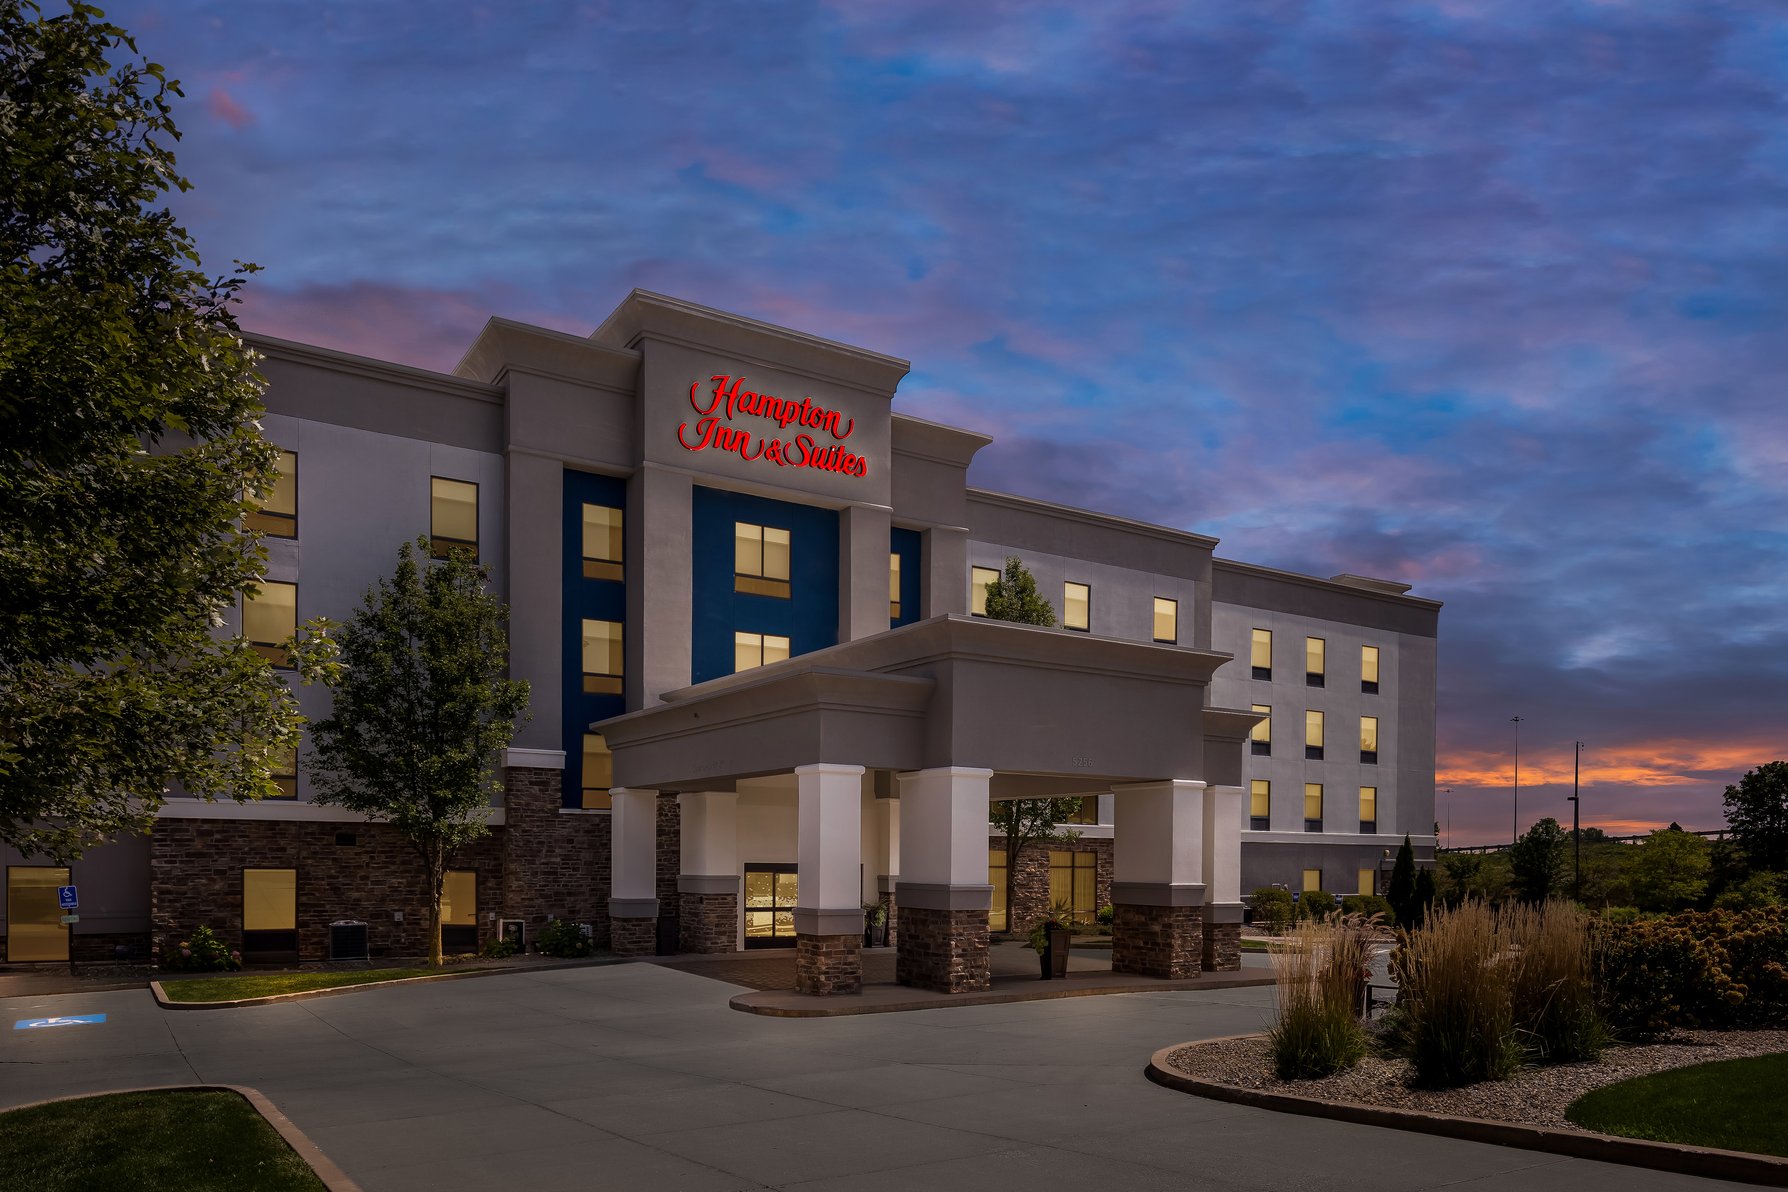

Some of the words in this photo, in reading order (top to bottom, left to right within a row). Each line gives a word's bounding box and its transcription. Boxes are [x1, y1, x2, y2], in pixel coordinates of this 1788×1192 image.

[690, 375, 854, 439] Hampton
[678, 417, 765, 461] Inn
[764, 439, 788, 466] &
[783, 433, 868, 477] Suites
[1072, 757, 1093, 767] 5256
